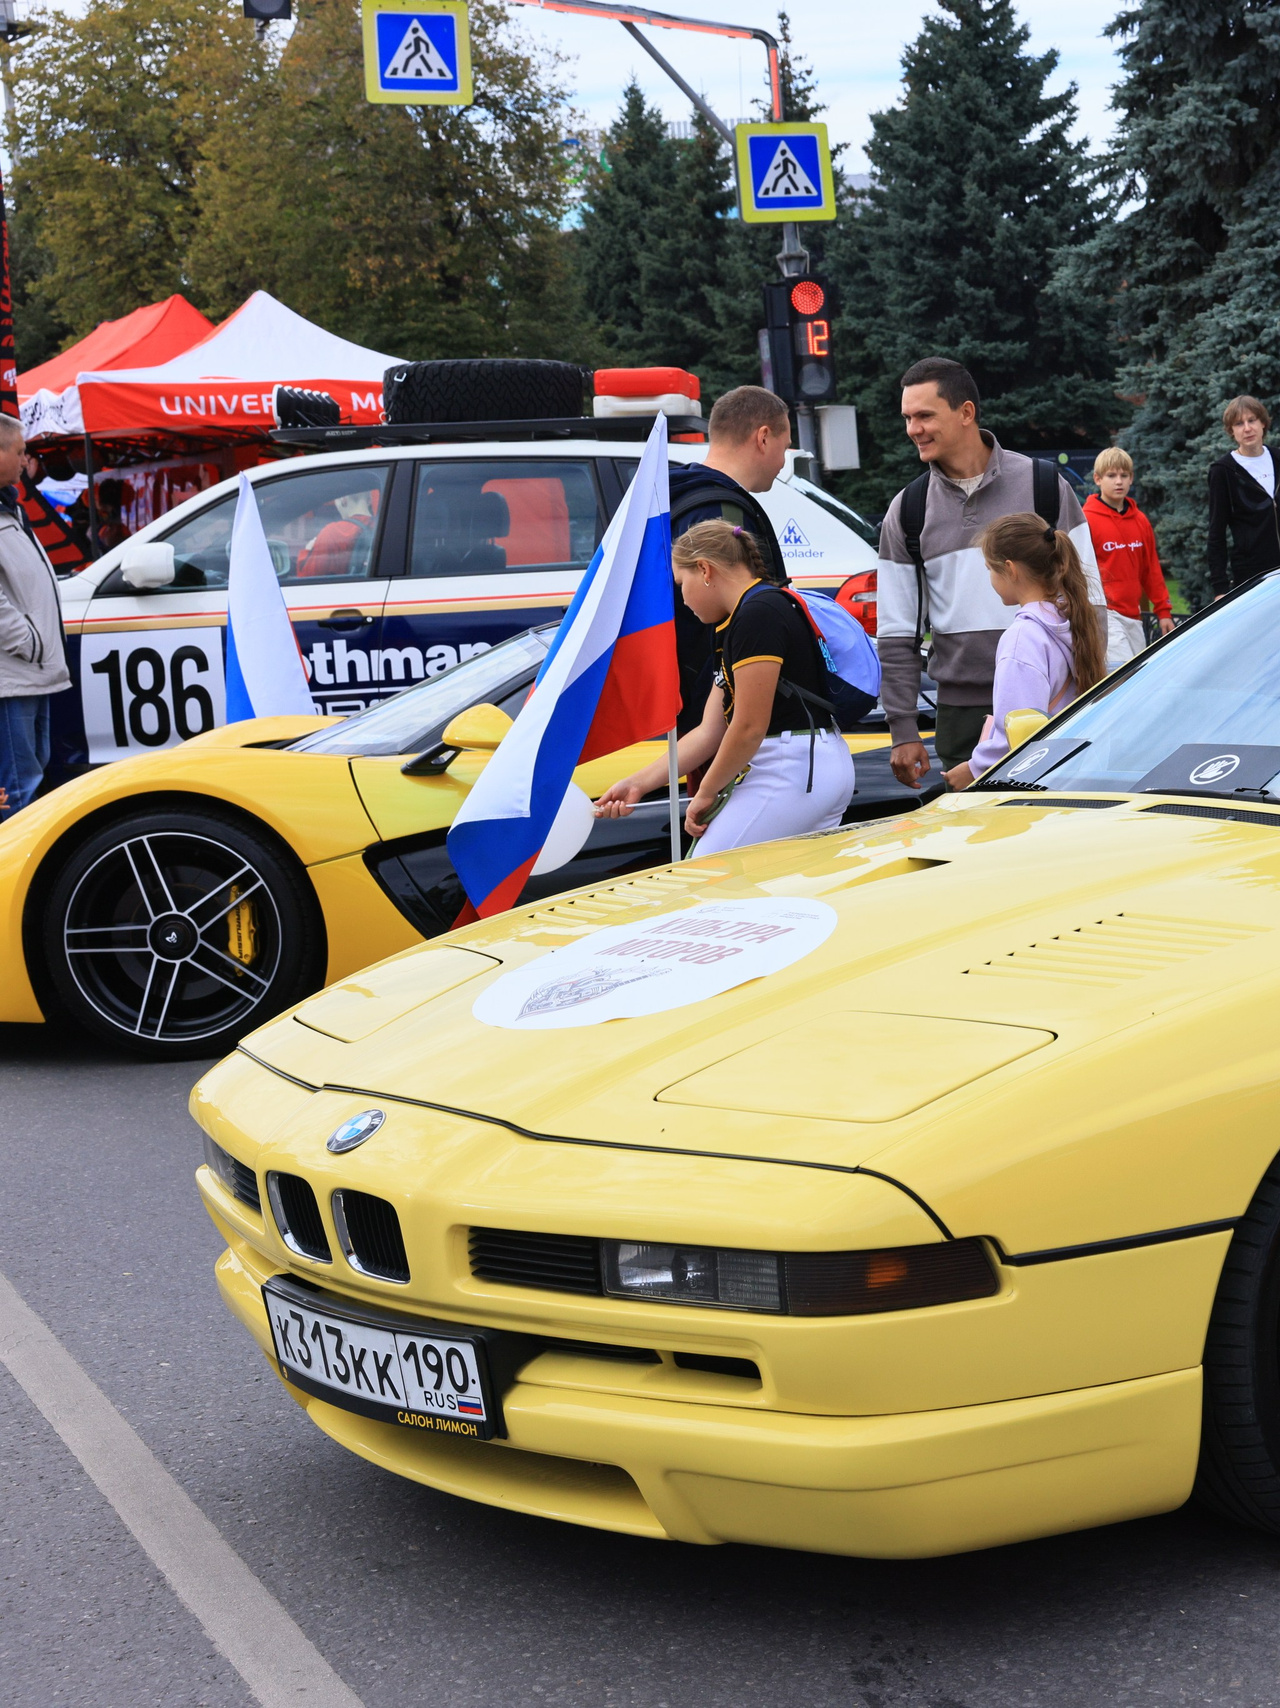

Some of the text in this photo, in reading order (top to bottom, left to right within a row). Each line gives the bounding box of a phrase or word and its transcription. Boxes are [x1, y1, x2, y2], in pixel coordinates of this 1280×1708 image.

[806, 320, 829, 356] 12
[351, 391, 385, 411] M
[91, 645, 215, 748] 186
[640, 917, 796, 944] КУЛЬТУРА
[593, 938, 744, 965] МОТОРОВ
[403, 1341, 469, 1394] 190
[424, 1390, 457, 1410] RUS
[397, 1411, 478, 1436] САЛОН ЛИМОН
